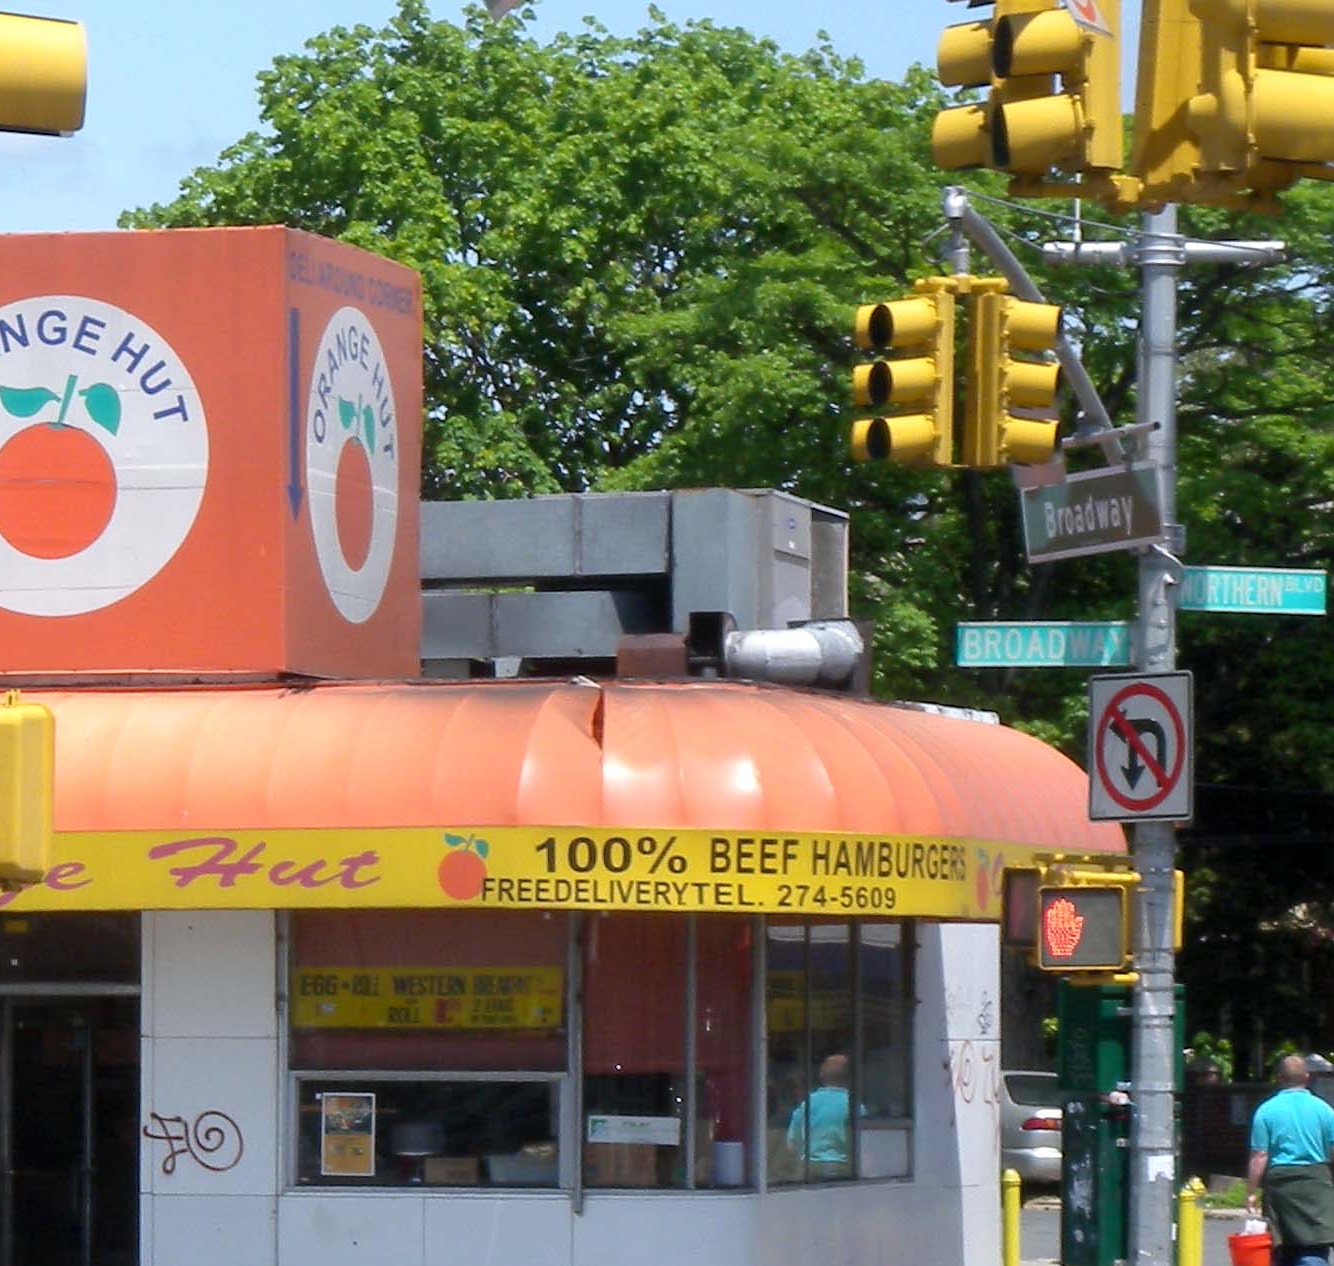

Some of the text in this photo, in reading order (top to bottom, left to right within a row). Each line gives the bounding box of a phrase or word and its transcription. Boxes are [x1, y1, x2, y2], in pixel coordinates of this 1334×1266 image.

[112, 332, 189, 423] HUT
[313, 325, 394, 459] ORANGE HUT
[1043, 495, 1133, 538] Broadway
[1182, 572, 1324, 606] NORTHERN BLVD
[962, 628, 1124, 662] BROADWAY
[148, 836, 382, 889] Hut
[534, 836, 688, 875] 100%
[710, 837, 800, 876] BEEF
[811, 840, 968, 882] HAMBURGERS
[777, 884, 897, 910] 274-5609
